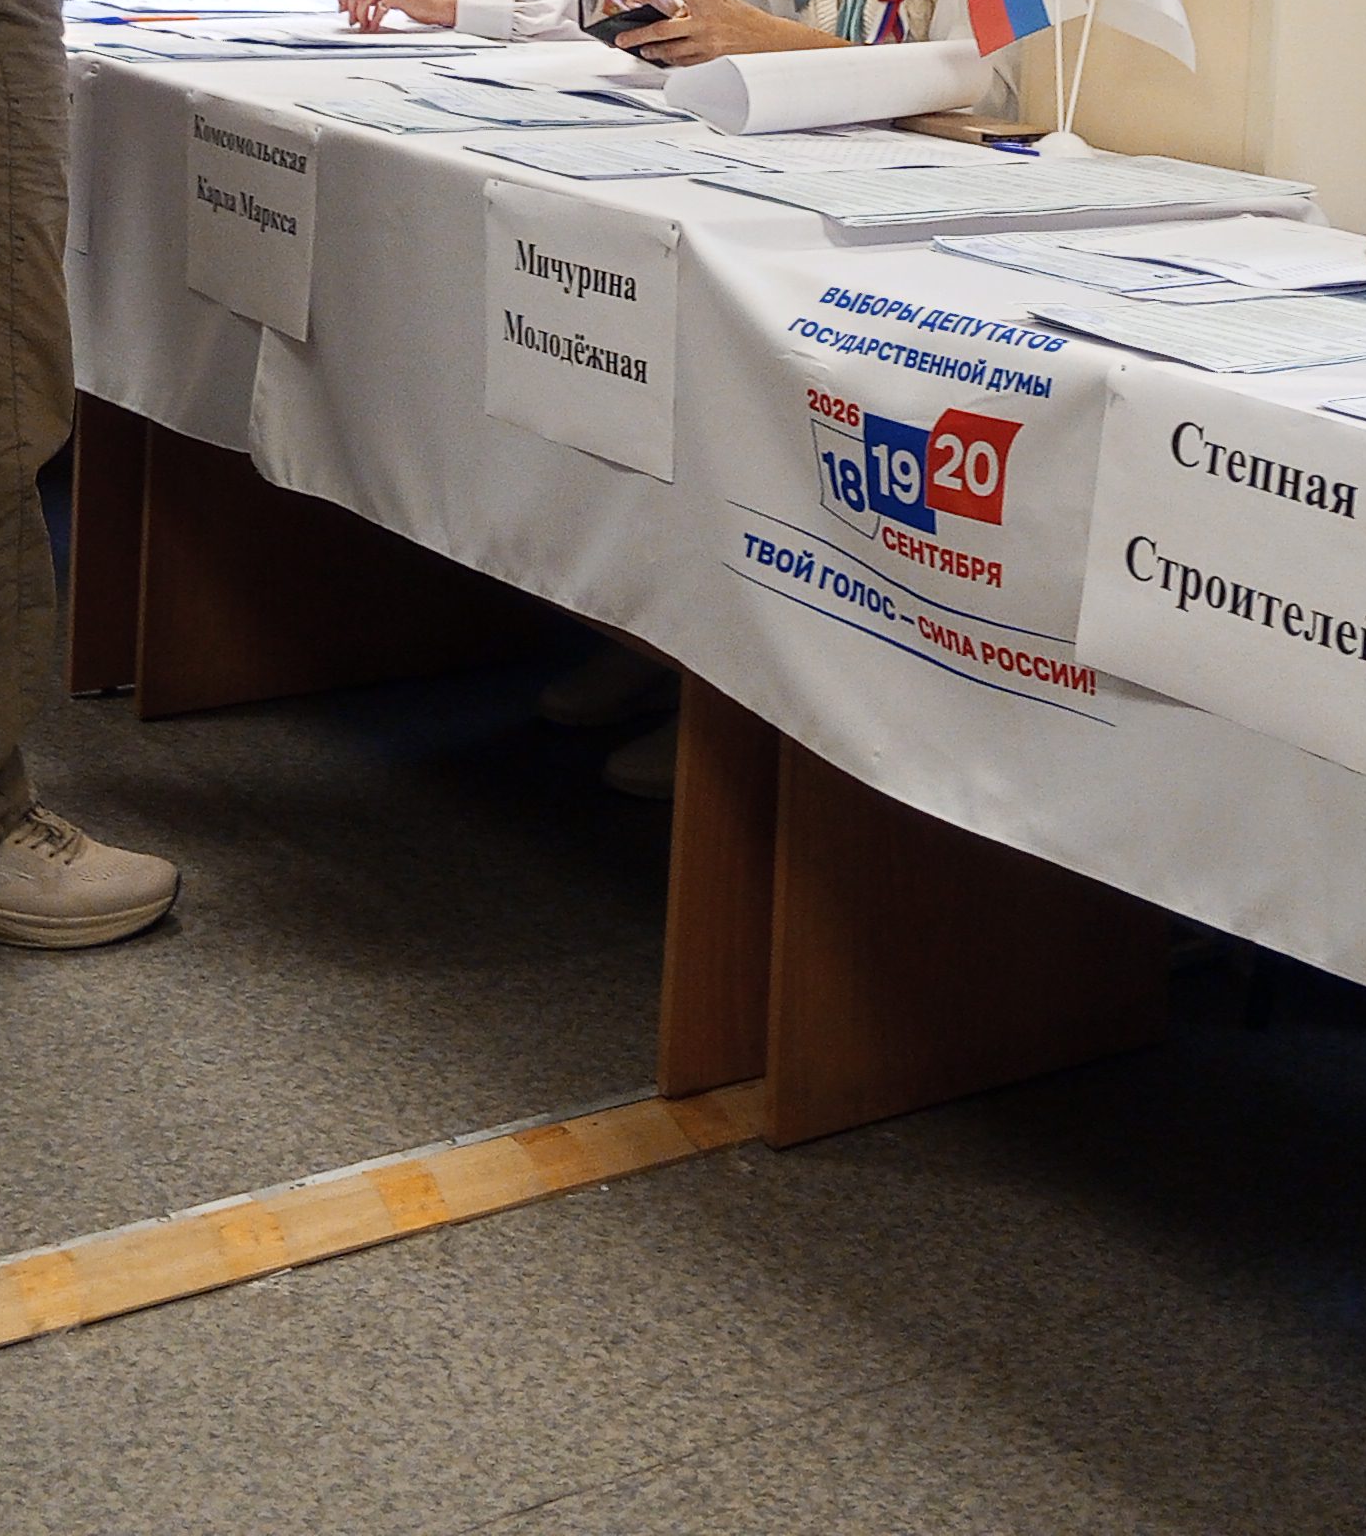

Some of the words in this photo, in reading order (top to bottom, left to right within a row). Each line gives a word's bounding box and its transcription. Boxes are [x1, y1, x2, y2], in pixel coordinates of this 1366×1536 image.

[194, 114, 307, 174] Комсомольская
[197, 175, 237, 213] Карла
[239, 192, 296, 236] Маркса
[515, 240, 636, 301] Мичурина
[504, 310, 647, 384] Молодёжная
[819, 287, 923, 322] ВЫБОРЫ
[918, 310, 1068, 352] ДЕПУТАТОВ
[788, 318, 986, 383] ГОСУДАРСТВЕННОЙ
[986, 368, 1052, 398] ДУМЫ
[807, 389, 859, 426] 2026
[821, 450, 867, 513] 18
[871, 443, 922, 505] 19
[932, 433, 1000, 498] 20
[1172, 422, 1358, 519] Степная
[882, 527, 1002, 588] СЕНТЯБРЯ
[744, 533, 815, 583] ТВОЙ
[819, 566, 895, 620] ГОЛОС
[918, 616, 978, 660] СИЛА
[981, 642, 1097, 696] РОССИИ!
